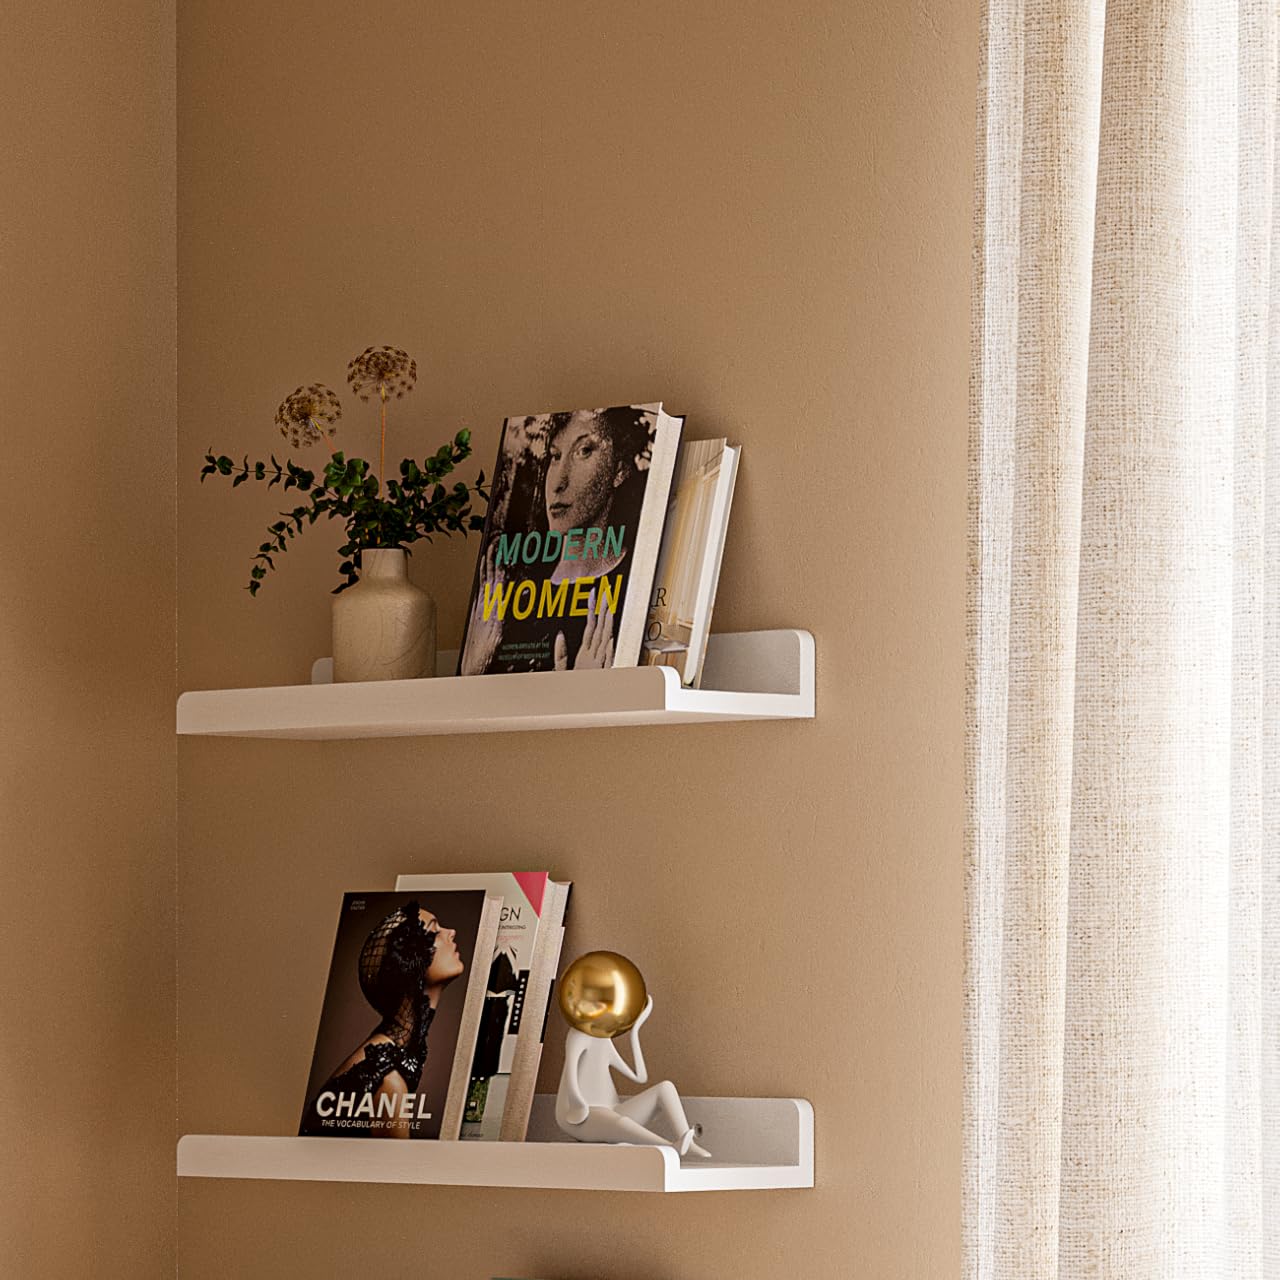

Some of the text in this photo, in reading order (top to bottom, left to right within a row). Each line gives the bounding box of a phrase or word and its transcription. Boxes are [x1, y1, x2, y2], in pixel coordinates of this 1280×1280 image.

[495, 525, 625, 567] MODERN
[482, 574, 623, 621] WOMEN
[316, 1091, 432, 1119] CHANEL
[321, 1119, 421, 1130] THE VOCABULARY OF STYLE
